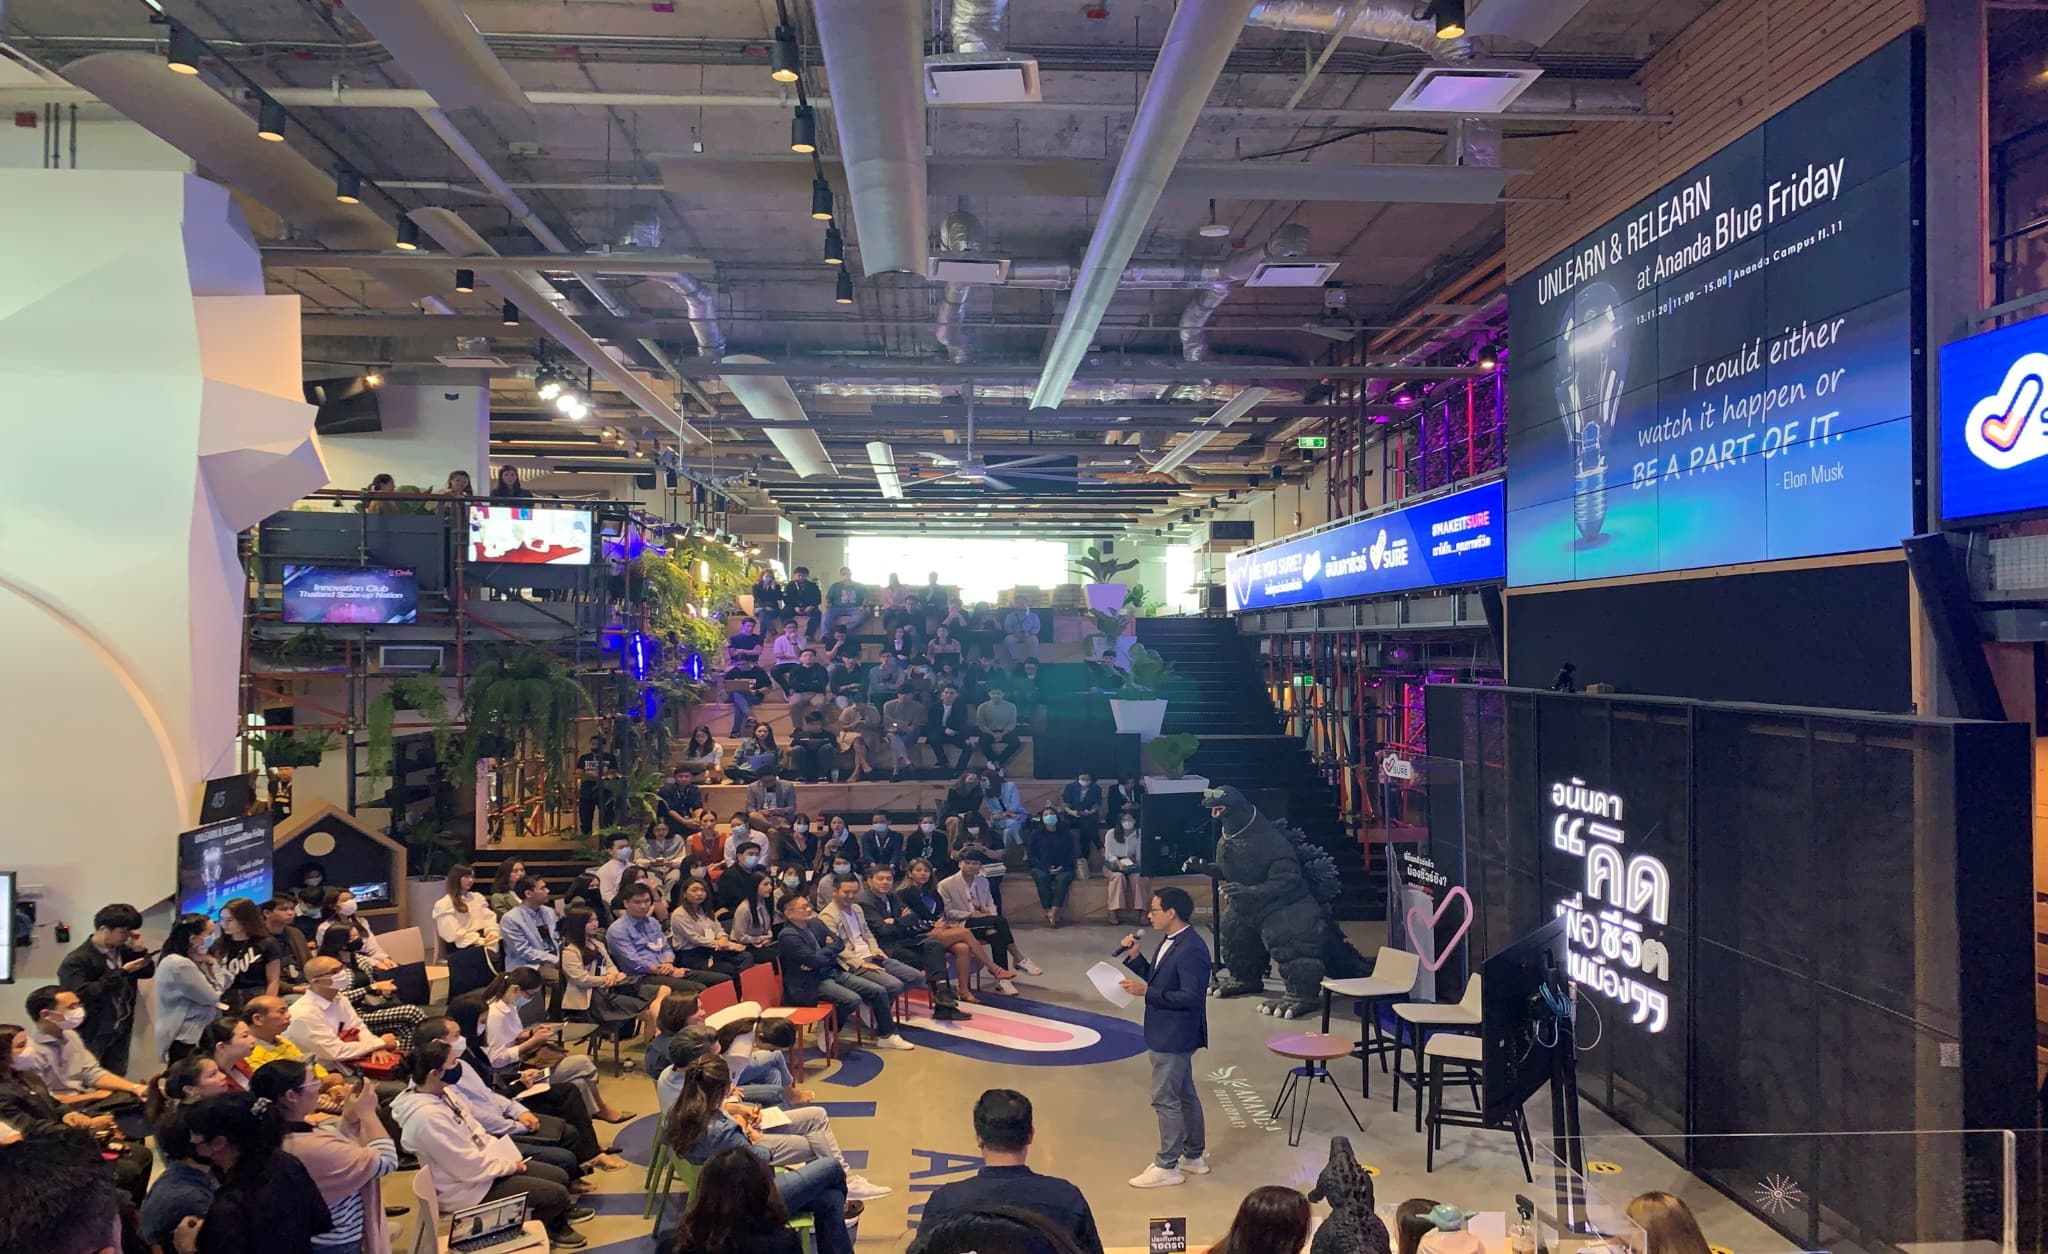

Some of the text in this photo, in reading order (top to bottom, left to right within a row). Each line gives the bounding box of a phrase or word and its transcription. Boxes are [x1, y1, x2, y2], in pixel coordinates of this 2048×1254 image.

[1538, 175, 1711, 305] UNLEARN & RELEARN
[1637, 157, 1845, 290] at Ananda Blue Friday
[1636, 303, 1668, 326] 13.11.20
[1704, 276, 1728, 294] 15.00
[1733, 256, 1770, 281] Ananda
[1773, 237, 1816, 262] Campus
[1692, 318, 1845, 391] I could either
[1638, 368, 1845, 447] watch it happen or
[1632, 411, 1842, 490] BE A PART OF IT.
[1784, 470, 1807, 490] Elon
[1811, 461, 1844, 484] Musk
[1432, 510, 1490, 537] #MAKEITSURE
[1383, 546, 1409, 569] SURE
[313, 584, 389, 592] Innovation Club
[1393, 766, 1408, 776] SURE
[1552, 777, 1623, 821] อนันดา
